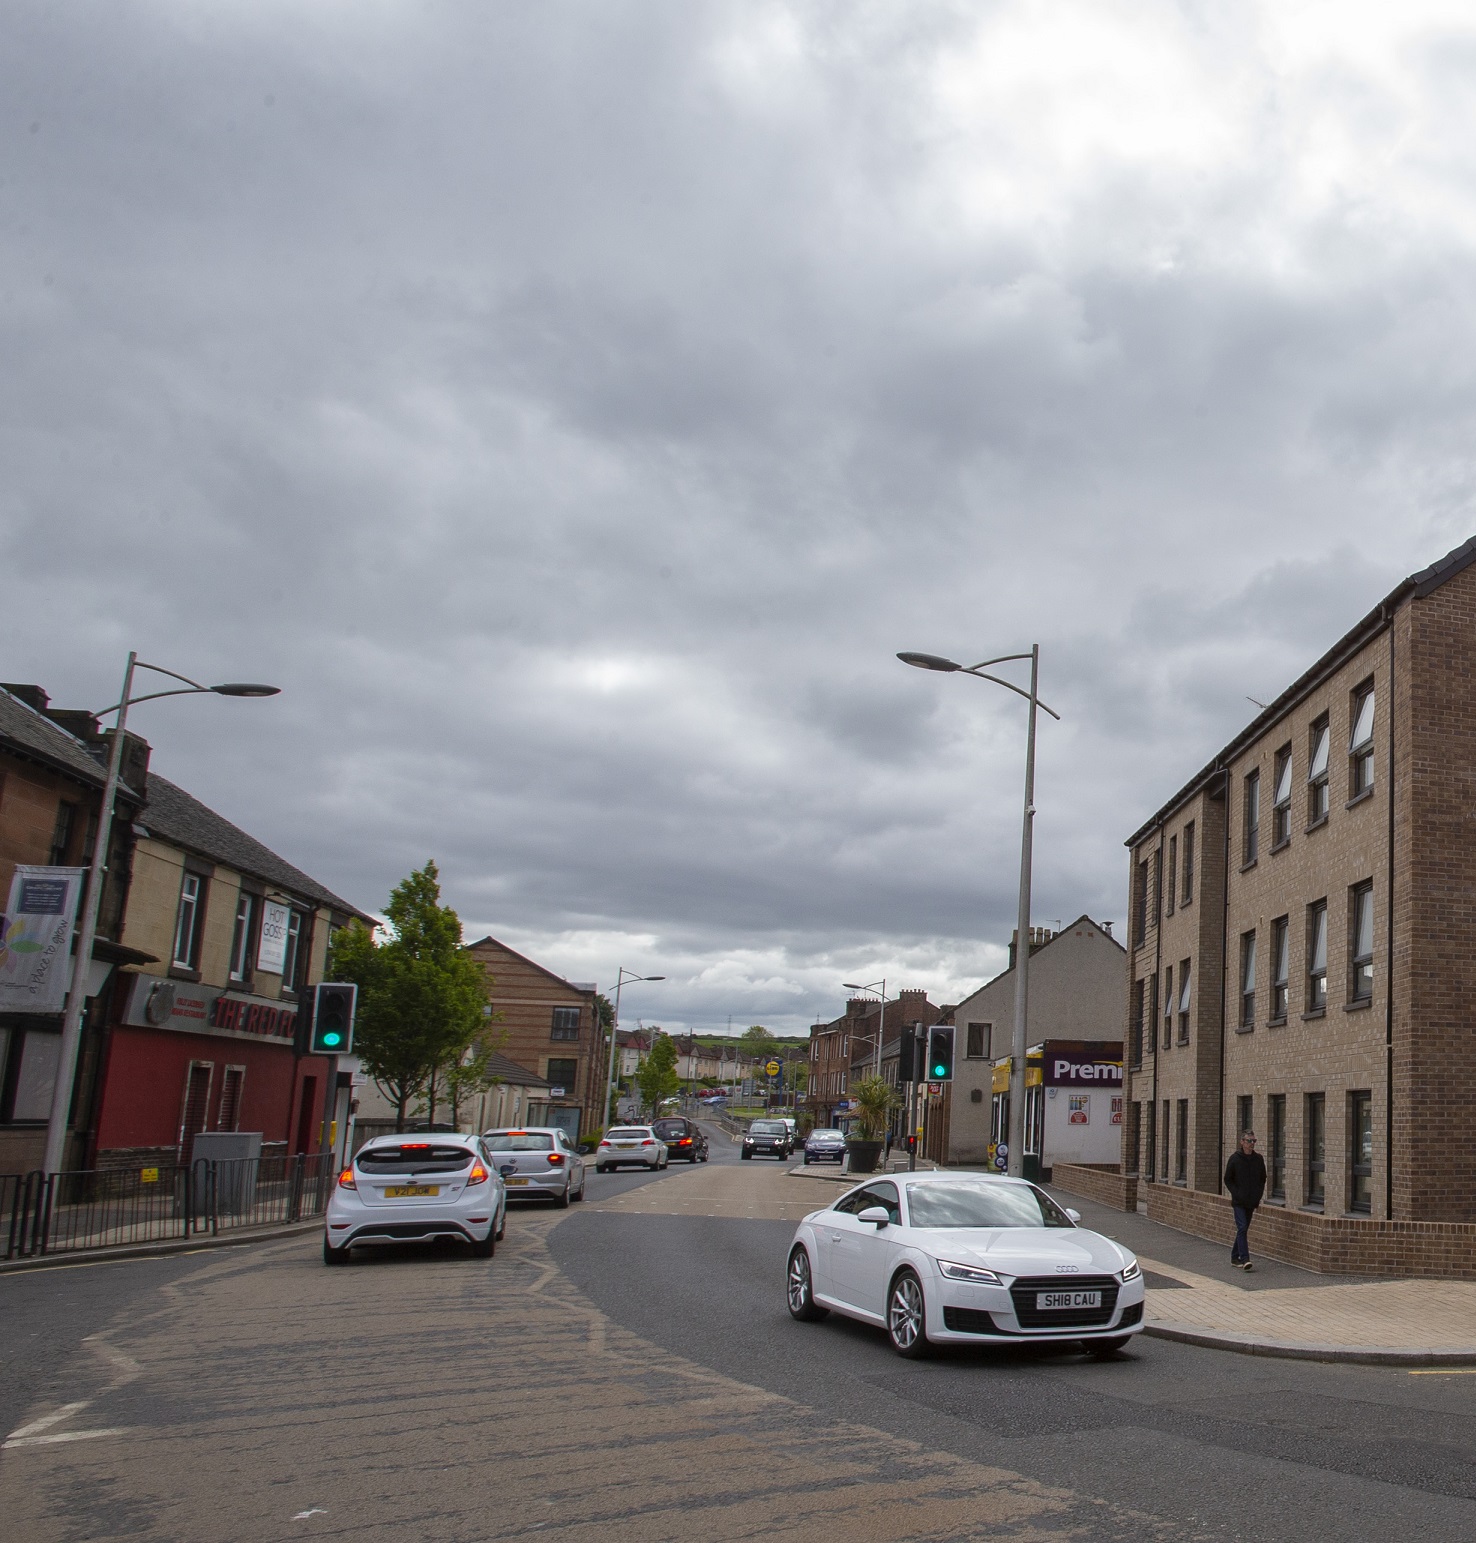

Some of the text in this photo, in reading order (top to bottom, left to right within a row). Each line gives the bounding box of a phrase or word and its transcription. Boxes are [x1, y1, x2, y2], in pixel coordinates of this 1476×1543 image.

[269, 908, 285, 924] HOT
[29, 919, 69, 994] a place to grow
[215, 997, 247, 1031] THE
[247, 1003, 278, 1035] RED
[1054, 1060, 1123, 1079] Premi
[1045, 1293, 1096, 1307] SH18 CAU
